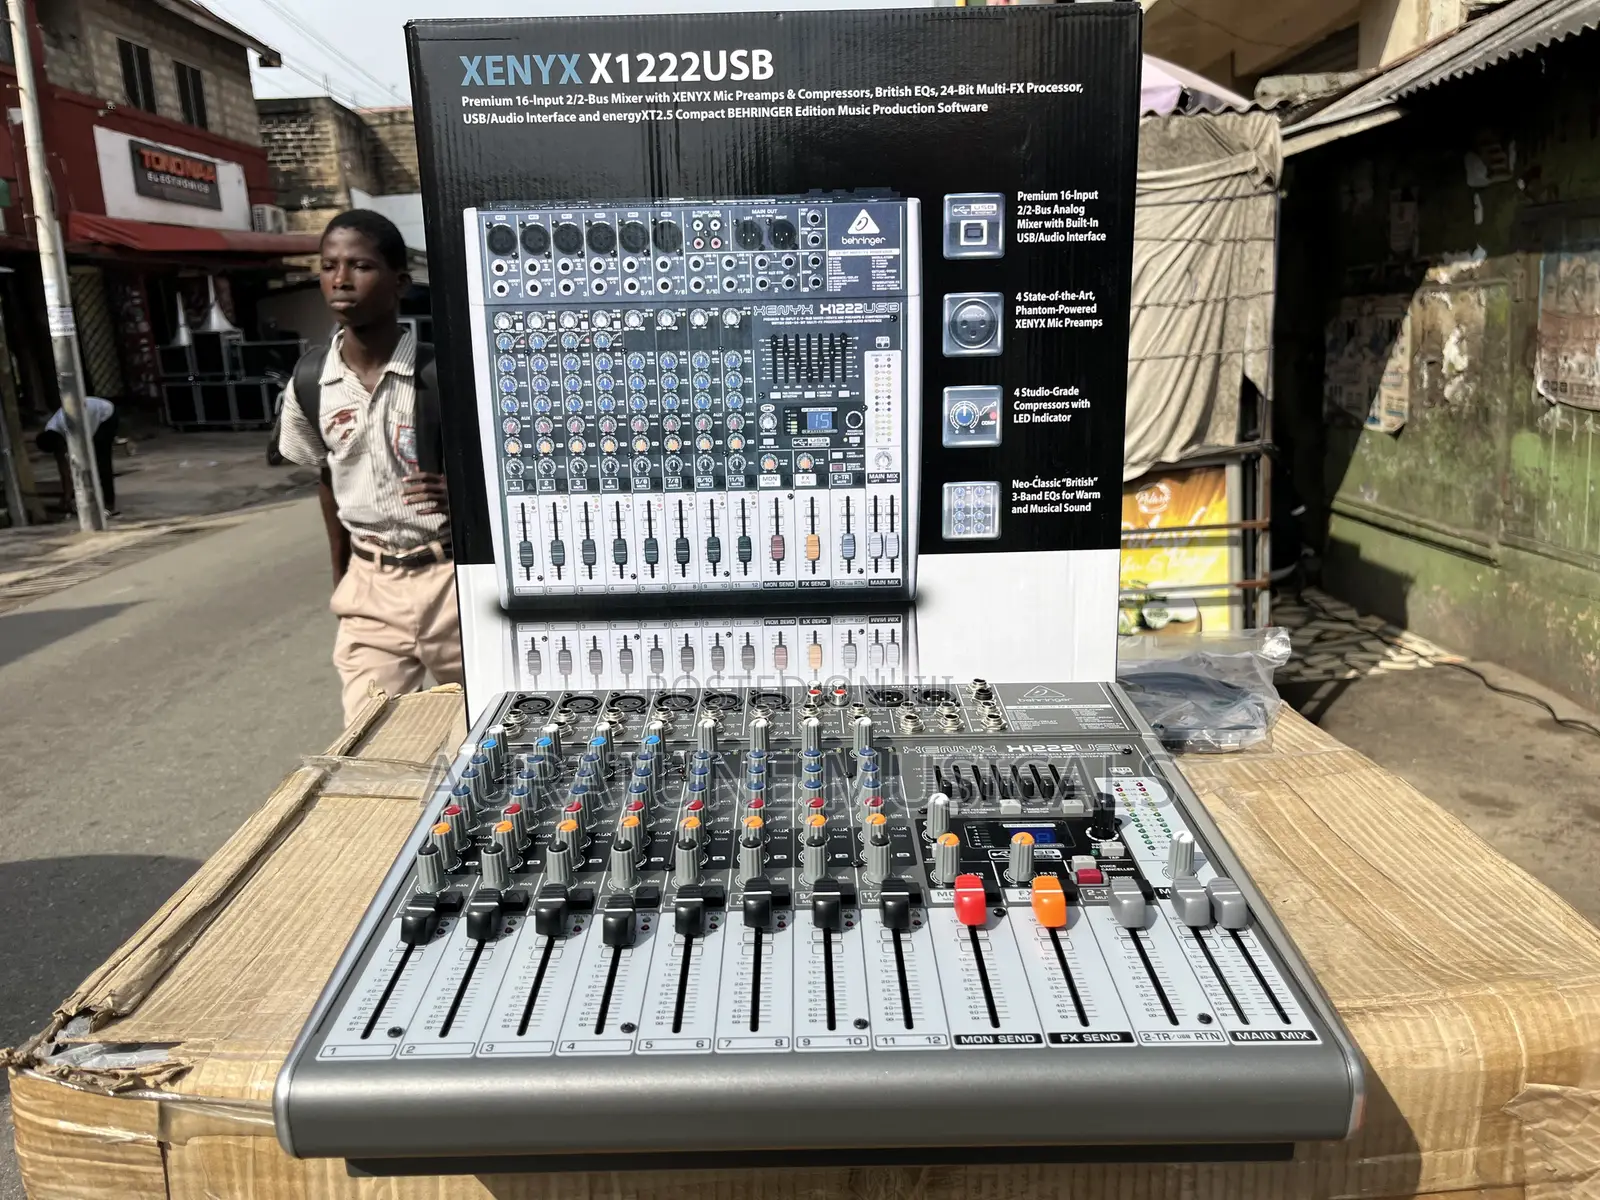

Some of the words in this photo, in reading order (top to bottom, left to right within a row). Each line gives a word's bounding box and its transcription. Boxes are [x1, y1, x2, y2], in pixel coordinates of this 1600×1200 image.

[459, 54, 582, 86] XENYX
[589, 49, 774, 84] X1222USB
[462, 95, 512, 107] Premium
[515, 94, 564, 107] 16-Input
[566, 93, 609, 105] 2/2-Bus
[611, 93, 643, 104] Mixer
[645, 92, 670, 104] with
[672, 91, 710, 103] XENYX
[712, 91, 733, 102] Mic
[735, 90, 783, 104] Preamps
[787, 89, 796, 99] &
[798, 87, 873, 101] Compressors,
[875, 86, 912, 98] British
[914, 85, 938, 98] EQs,
[940, 84, 974, 96] 24-Bit
[976, 83, 1024, 95] Multi-FX
[1027, 82, 1084, 95] Processor,
[463, 112, 524, 125] USB/Audio
[526, 111, 576, 124] Interface
[578, 110, 600, 122] and
[602, 109, 673, 124] energyXT2.5
[675, 108, 725, 122] Compact
[727, 105, 793, 119] BEHRINGER
[795, 104, 836, 117] Edition
[837, 103, 870, 116] Music
[873, 102, 936, 115] Production
[937, 101, 989, 113] Software
[1017, 190, 1058, 201] Premium
[1060, 190, 1099, 202] 16-Input
[1017, 204, 1052, 215] 2/2-Bus
[1053, 204, 1086, 216] Analog
[1017, 219, 1043, 229] Mixer
[1044, 218, 1064, 228] with
[1065, 217, 1099, 228] Built-In
[841, 236, 887, 246] behringer
[1017, 232, 1065, 243] USB/Audio
[1066, 231, 1107, 242] Interface
[1015, 292, 1022, 302] 4
[1023, 290, 1096, 302] State-of-the-Art,
[753, 304, 814, 316] XENYX
[820, 302, 900, 314] X1222USB
[1015, 303, 1097, 315] Phantom-Powered
[1015, 319, 1046, 329] XENYX
[1047, 318, 1063, 328] Mic
[1064, 317, 1103, 329] Preamps
[1013, 387, 1020, 398] 4
[1021, 386, 1080, 397] Studio-Grade
[1013, 400, 1070, 412] Compressors
[1071, 398, 1091, 409] with
[1013, 413, 1031, 423] LED
[1032, 412, 1072, 423] Indicator
[1012, 477, 1061, 489] Neo-Classic
[1061, 476, 1098, 487] “British”
[1012, 491, 1043, 501] 3-Band
[1044, 491, 1060, 501] EQs
[1061, 490, 1075, 500] for
[1076, 490, 1101, 500] Warm
[1011, 504, 1029, 514] and
[1030, 503, 1063, 513] Musical
[1063, 502, 1092, 513] Sound
[1007, 744, 1133, 753] X1222USB
[882, 1037, 896, 1045] 11
[925, 1036, 941, 1045] 12
[961, 1035, 994, 1044] MON
[998, 1035, 1035, 1043] SEND
[1061, 1034, 1082, 1043] FX
[1083, 1033, 1121, 1042] SEND
[1194, 1031, 1220, 1041] RTN
[1236, 1031, 1277, 1041] MAIN
[1279, 1031, 1311, 1040] MIX
[567, 1042, 575, 1050] 4
[645, 1041, 653, 1049] 5
[696, 1040, 704, 1048] 6
[724, 1040, 732, 1048] 7
[775, 1039, 783, 1047] 8
[803, 1038, 811, 1046] 9
[846, 1037, 863, 1046] 10
[328, 1047, 337, 1056] 1
[406, 1045, 416, 1054] 2
[485, 1044, 494, 1053] 3
